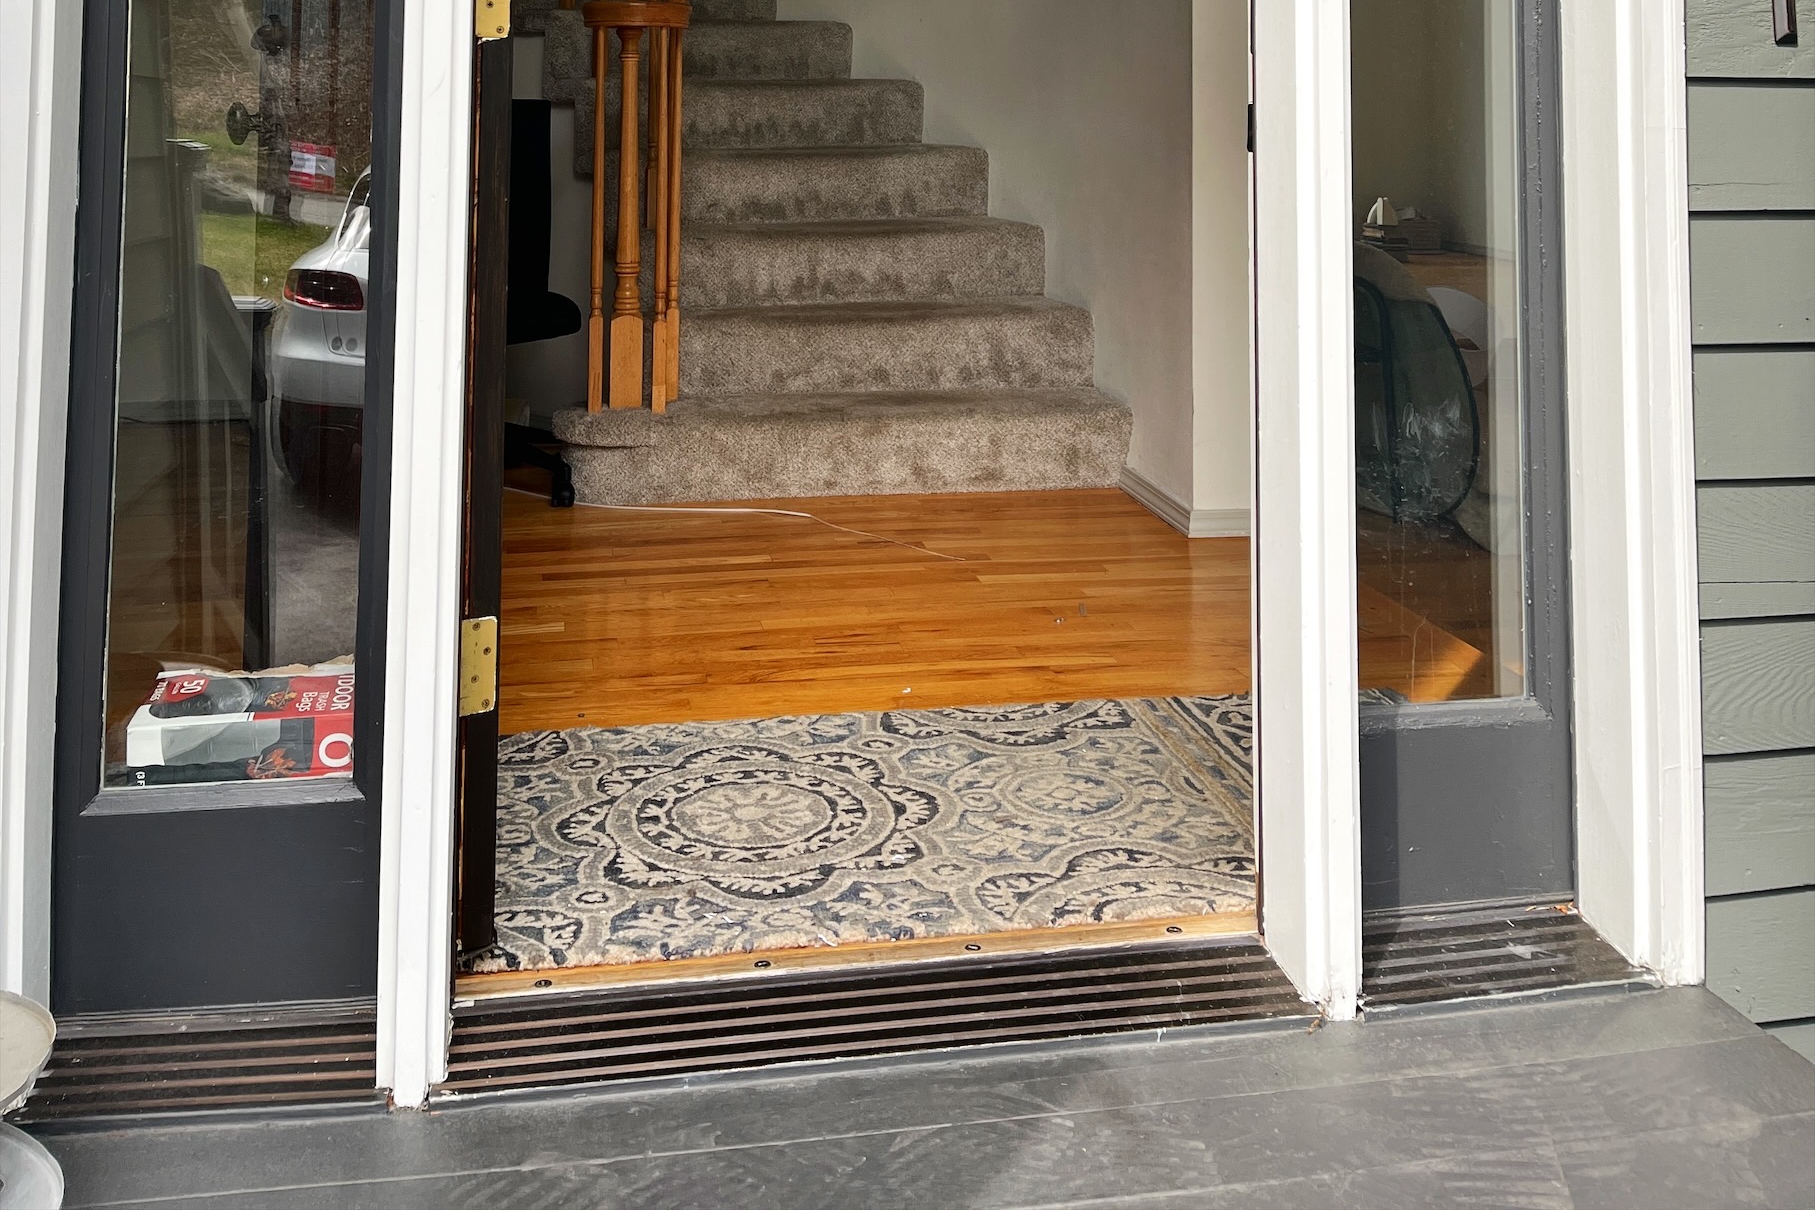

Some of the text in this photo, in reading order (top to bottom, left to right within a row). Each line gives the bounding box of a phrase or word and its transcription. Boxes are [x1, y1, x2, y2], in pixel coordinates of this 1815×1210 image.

[180, 679, 206, 694] 50
[295, 691, 318, 712] Bags
[314, 691, 330, 712] TRASH
